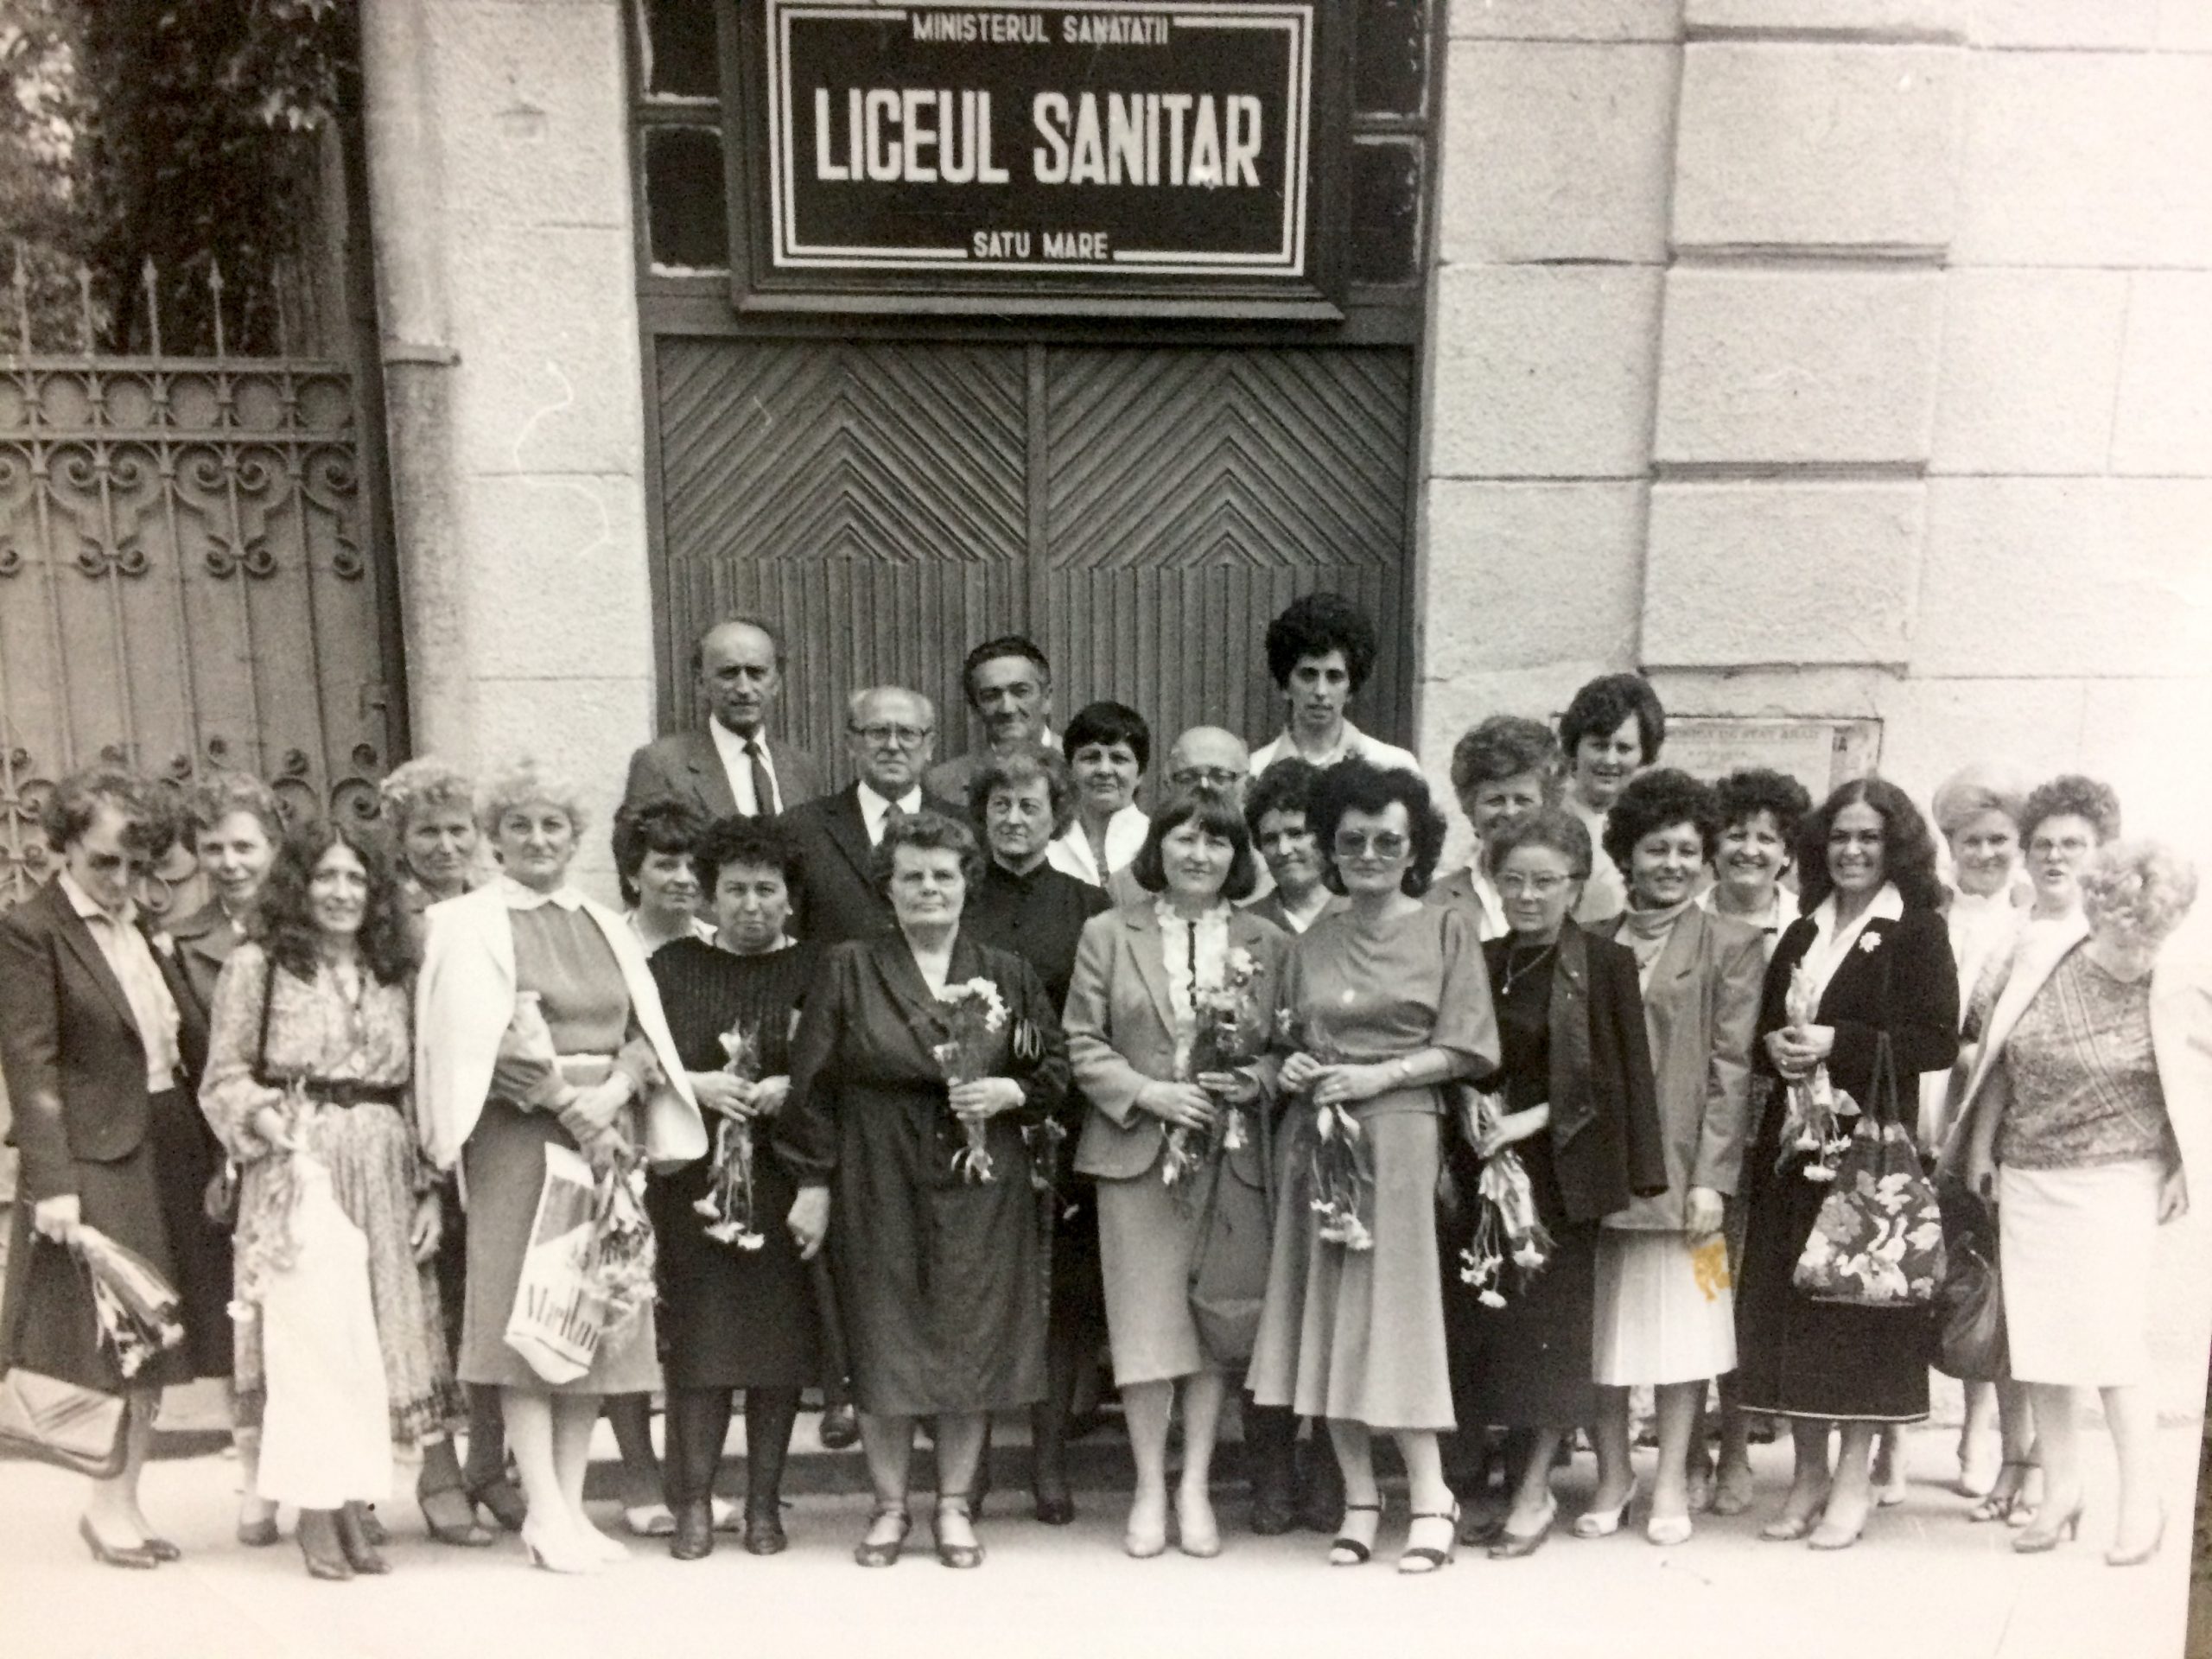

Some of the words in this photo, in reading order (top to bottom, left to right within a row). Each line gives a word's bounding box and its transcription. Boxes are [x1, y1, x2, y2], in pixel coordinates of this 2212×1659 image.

[912, 13, 1051, 43] MINISTERUL
[1063, 15, 1168, 44] SANATATII
[815, 87, 1010, 184] LICEUL
[1033, 91, 1263, 188] SANITAR
[973, 230, 1031, 258] SATU
[1042, 232, 1109, 259] MARE
